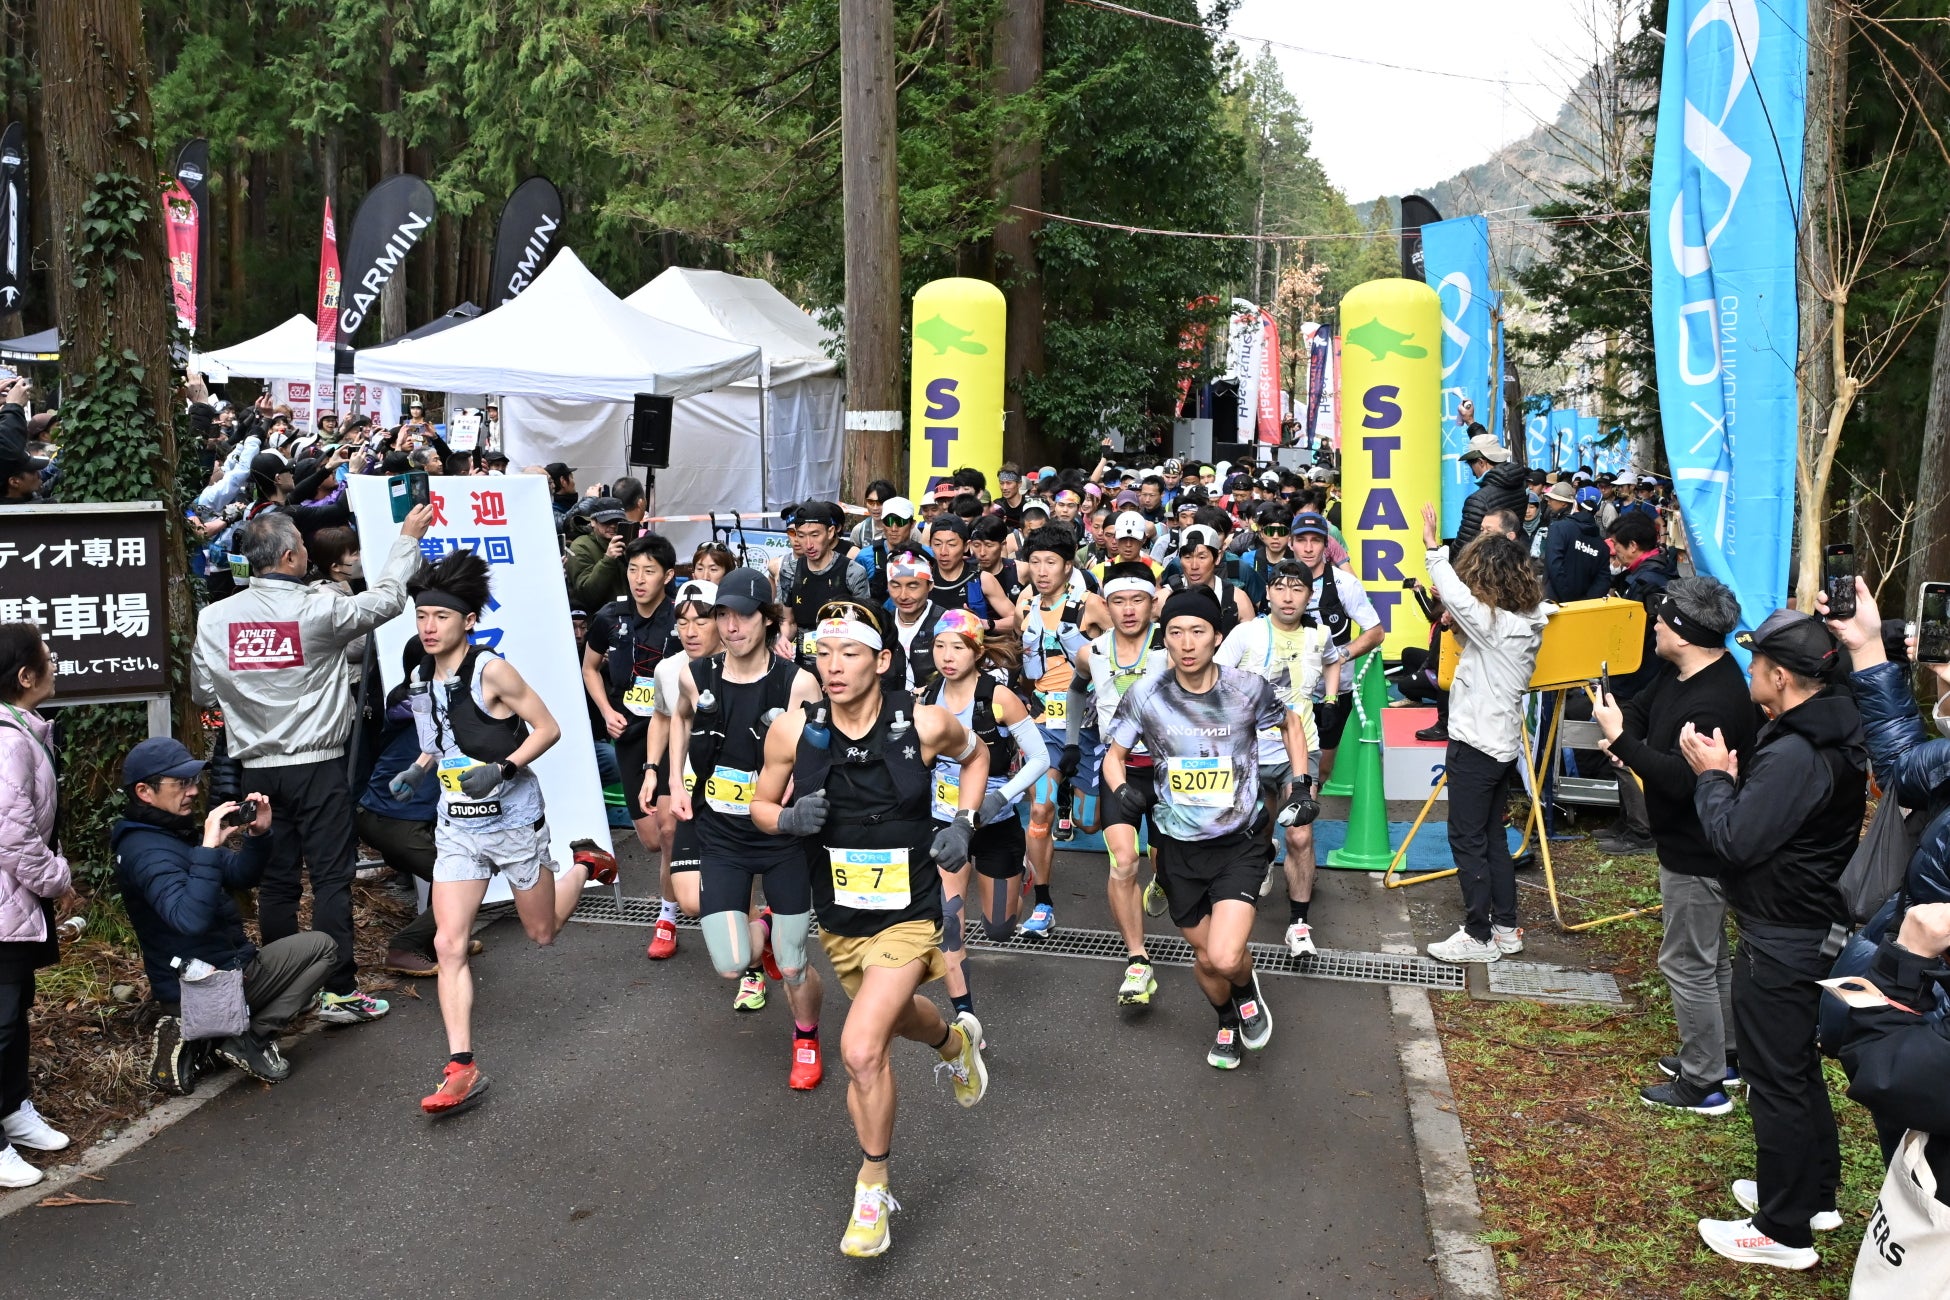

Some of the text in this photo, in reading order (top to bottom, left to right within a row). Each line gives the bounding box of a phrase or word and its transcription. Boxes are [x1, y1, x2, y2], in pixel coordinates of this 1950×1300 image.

[502, 213, 557, 305] RMIN
[340, 211, 428, 333] GARMIN
[1357, 384, 1410, 633] START
[237, 628, 277, 638] ATHLETE
[53, 656, 160, 677] 車して下さい。
[450, 804, 498, 816] STUDIO.G
[871, 868, 884, 889] 7
